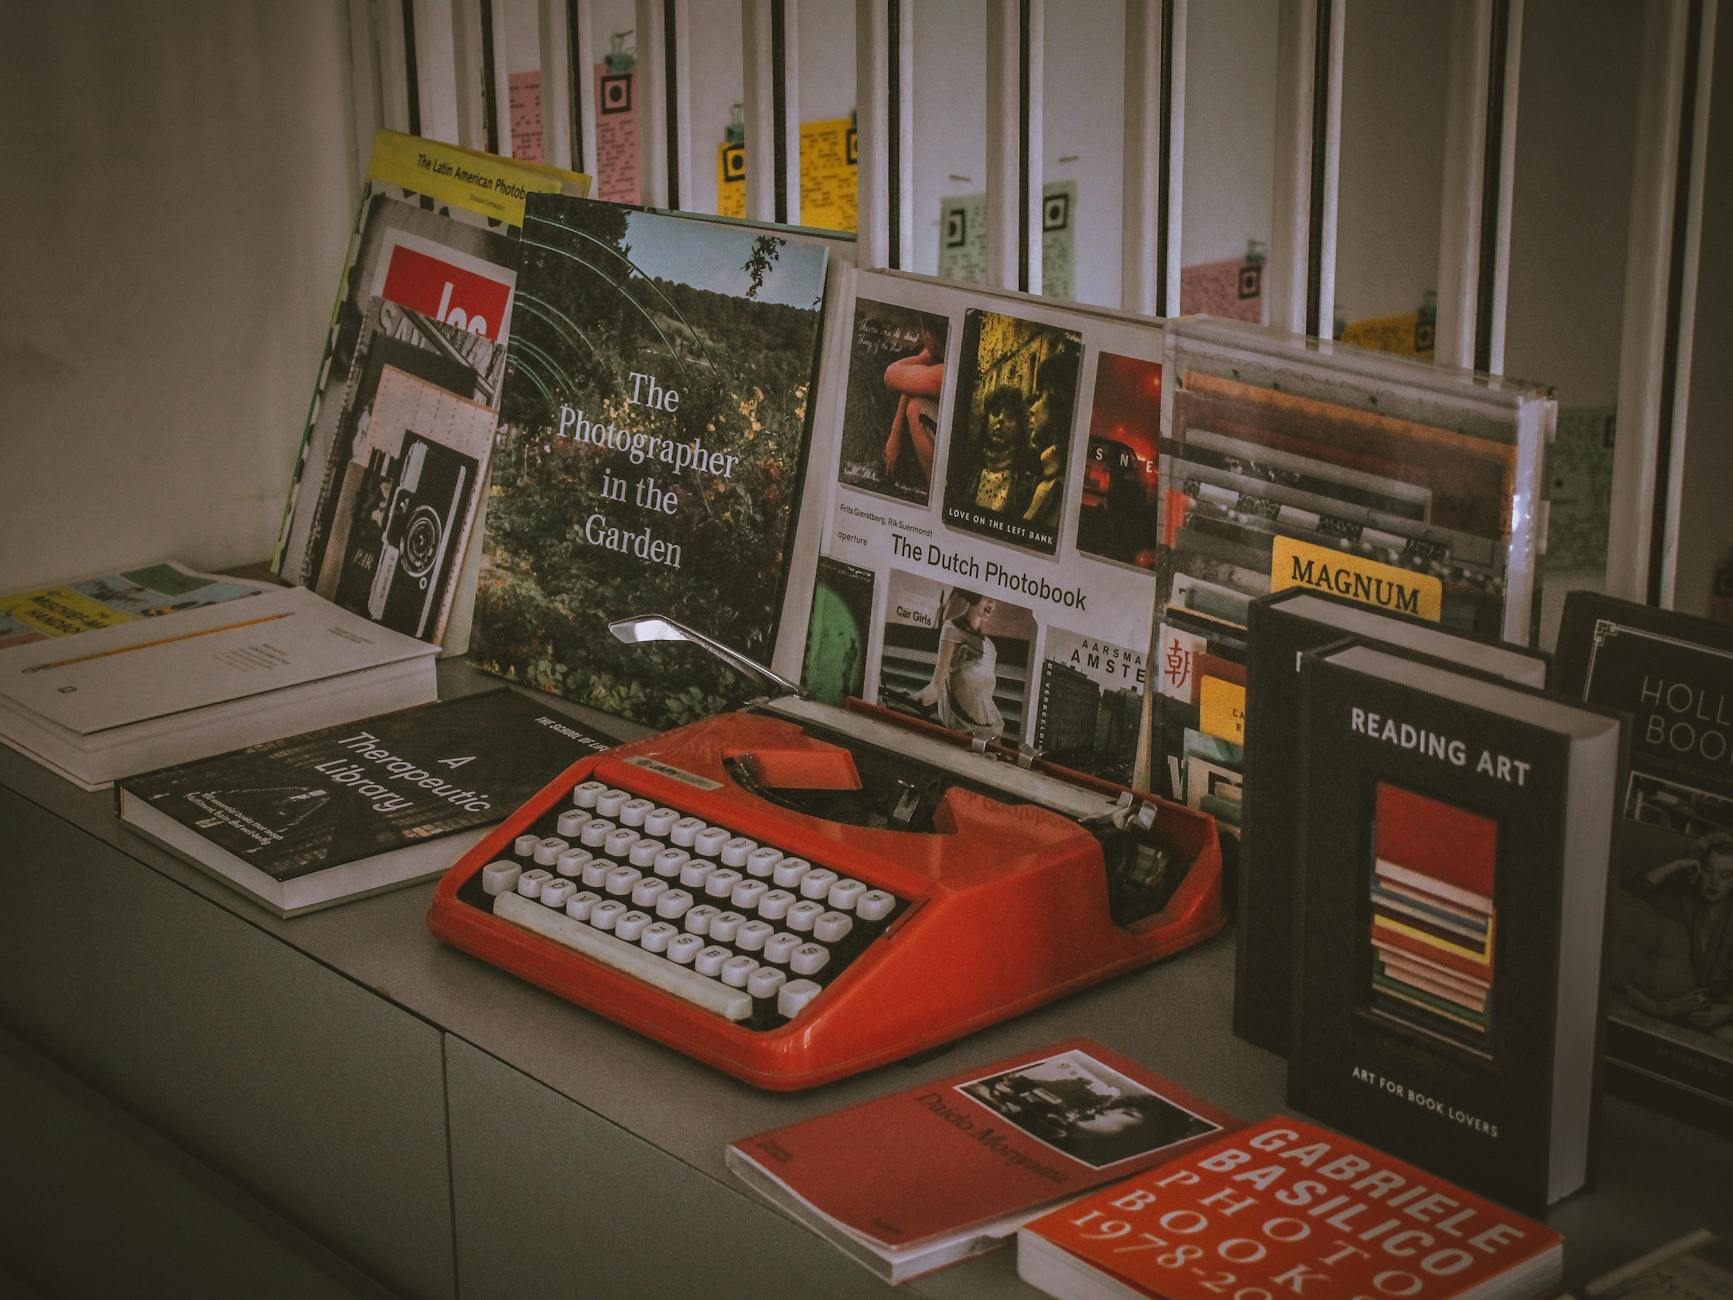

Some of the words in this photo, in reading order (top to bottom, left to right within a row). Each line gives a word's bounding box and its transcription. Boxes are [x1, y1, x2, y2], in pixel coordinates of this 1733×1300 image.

[417, 154, 432, 169] The
[433, 160, 453, 177] Latin
[454, 167, 494, 190] American
[629, 371, 680, 412] The
[557, 405, 739, 479] Photographer
[600, 467, 626, 502] in
[636, 477, 679, 515] the
[839, 504, 854, 517] Frits
[887, 518, 898, 529] Rik
[585, 513, 681, 568] Garden
[837, 531, 868, 546] aperture
[949, 507, 970, 521] LOVE
[973, 515, 986, 525] ON
[989, 517, 1004, 532] THE
[1007, 524, 1026, 537] LEFT
[1029, 530, 1053, 545] BANK
[891, 533, 922, 562] The
[928, 545, 980, 579] Dutch
[985, 561, 1088, 611] Photobook
[1291, 555, 1421, 615] MAGNUM
[896, 605, 912, 619] Car
[912, 609, 932, 627] Girls
[1071, 649, 1146, 684] AMSTE
[1082, 639, 1148, 666] AARSMA
[1641, 675, 1731, 726] HOLL
[338, 731, 491, 812] Therapeutic
[437, 755, 477, 769] A
[1351, 707, 1467, 766] READING
[1476, 750, 1531, 786] ART
[314, 757, 414, 813] Library
[1352, 1066, 1376, 1085] ART
[1379, 1077, 1404, 1097] FOR
[1407, 1089, 1444, 1114] BOOK
[1448, 1107, 1499, 1138] LOVERS
[1197, 1148, 1474, 1277] BASILICO
[1249, 1127, 1525, 1255] GABRIELE
[1112, 1189, 1376, 1300] BOOK
[1154, 1168, 1423, 1297] PHOTO
